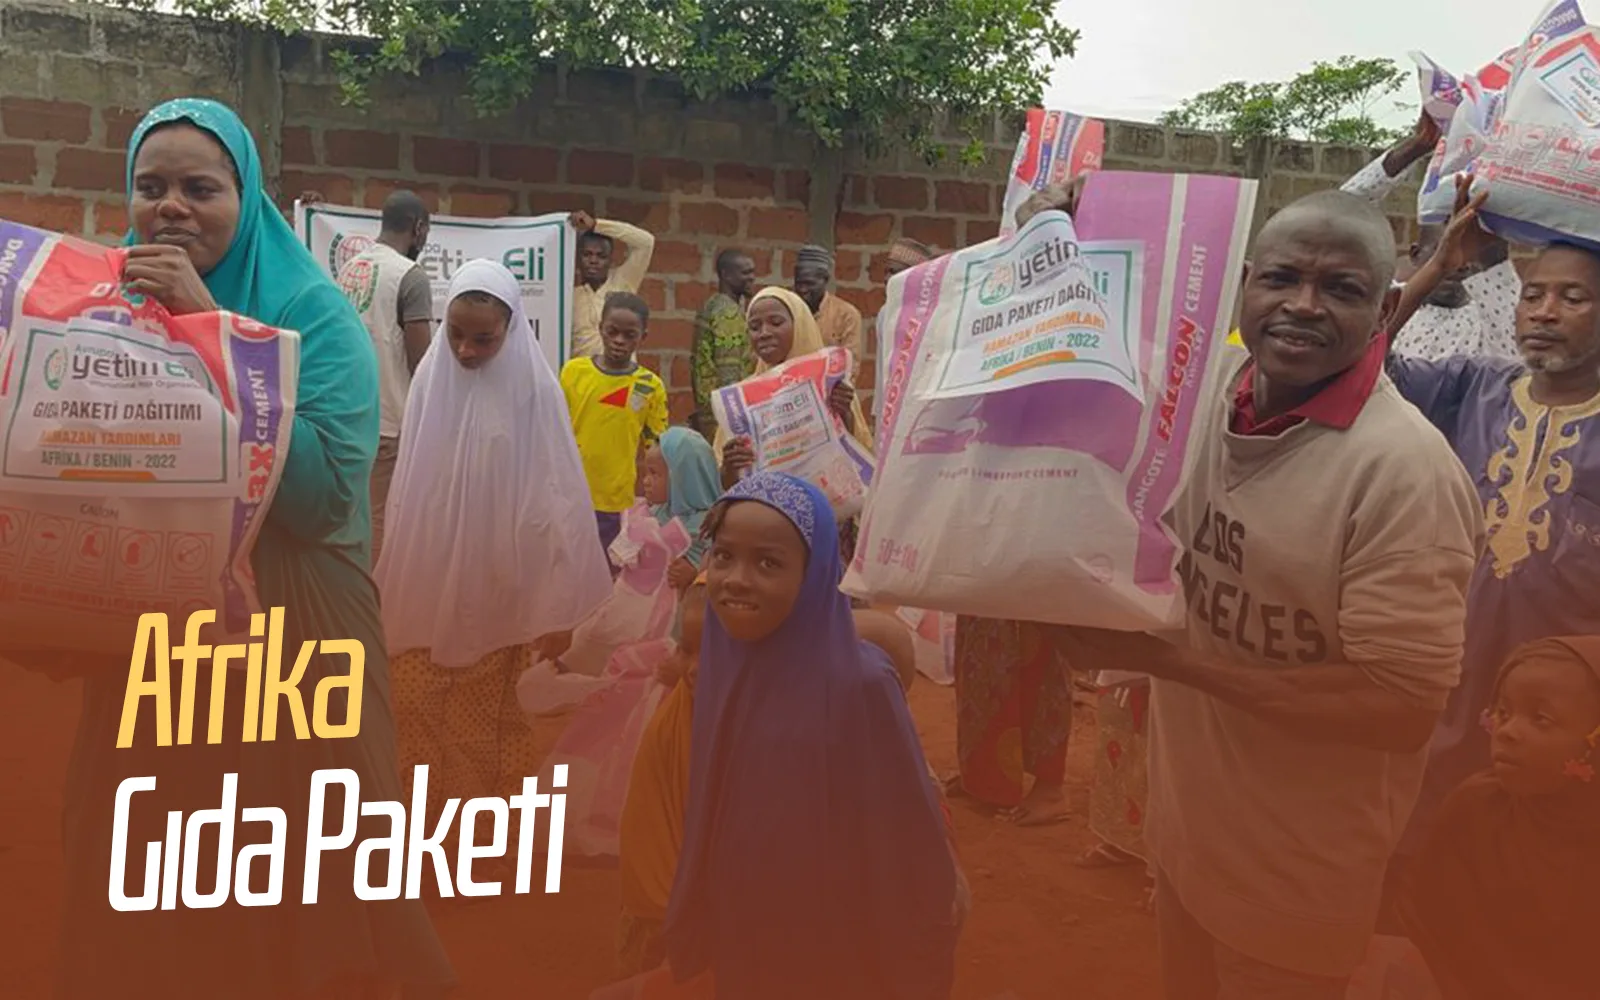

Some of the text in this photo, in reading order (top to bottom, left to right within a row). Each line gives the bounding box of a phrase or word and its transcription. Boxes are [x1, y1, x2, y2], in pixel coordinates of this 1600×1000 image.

[503, 247, 545, 281] Eli
[1184, 245, 1208, 313] CEMENT
[971, 312, 1004, 336] GIDA
[1066, 332, 1100, 350] 2022
[1157, 314, 1197, 444] FALCON
[123, 398, 202, 421] DAĞITIMI
[247, 367, 270, 441] CEMENT
[145, 453, 177, 469] 2022
[1193, 501, 1245, 575] LOS
